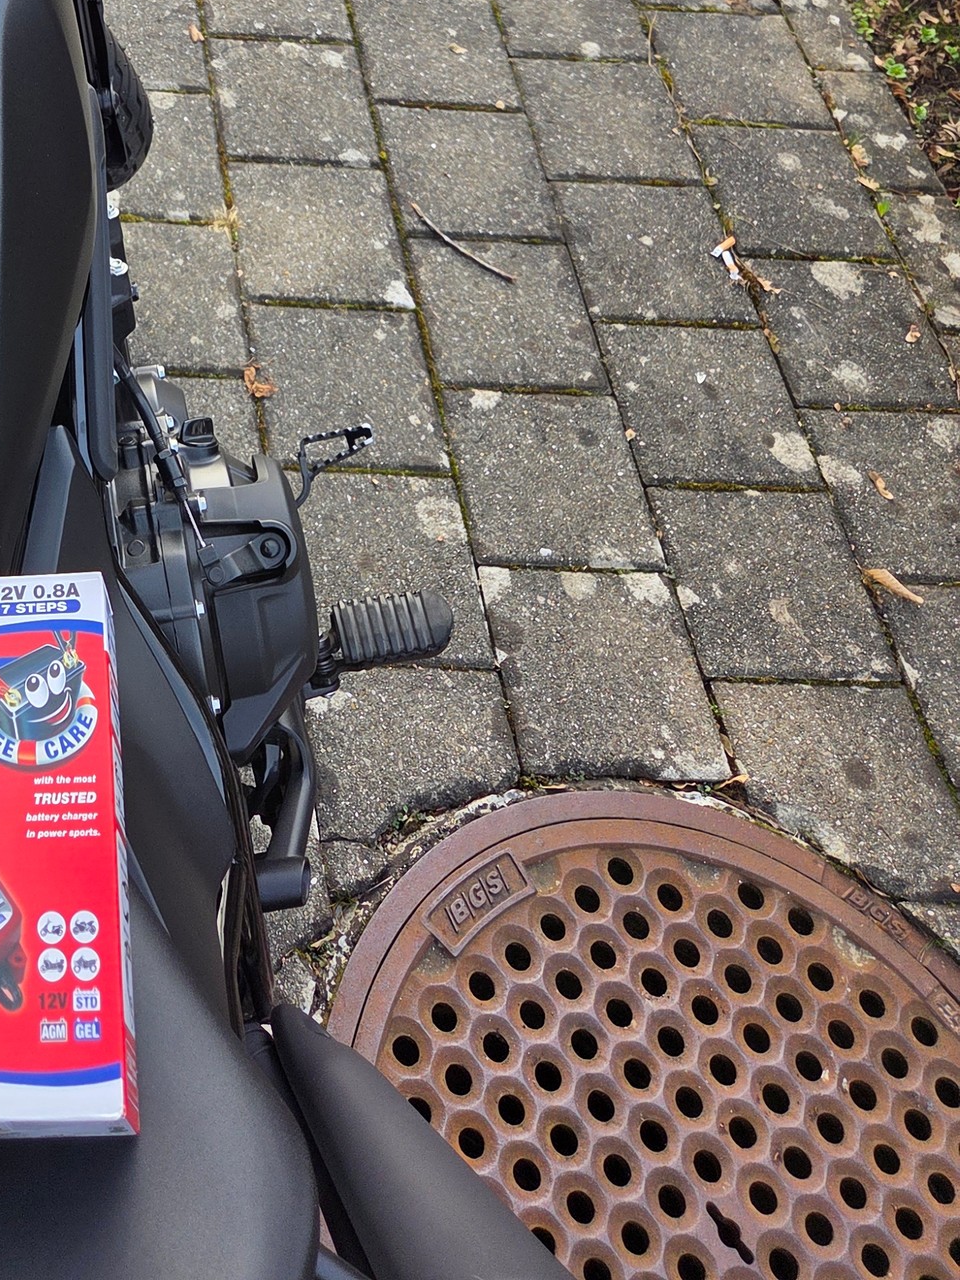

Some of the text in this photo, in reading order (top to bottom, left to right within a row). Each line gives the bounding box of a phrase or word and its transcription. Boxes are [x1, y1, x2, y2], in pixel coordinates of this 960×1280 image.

[33, 585, 80, 599] 0.8A
[1, 602, 68, 614] 7 STEPS
[44, 713, 93, 760] CARE
[34, 775, 96, 785] with the most
[34, 792, 96, 805] TRUSTED
[26, 810, 98, 822] battery charger
[26, 828, 100, 840] in power sports.
[450, 867, 506, 926] BGS
[38, 993, 98, 1009] 12V STD
[41, 1021, 100, 1039] AGM GEL
